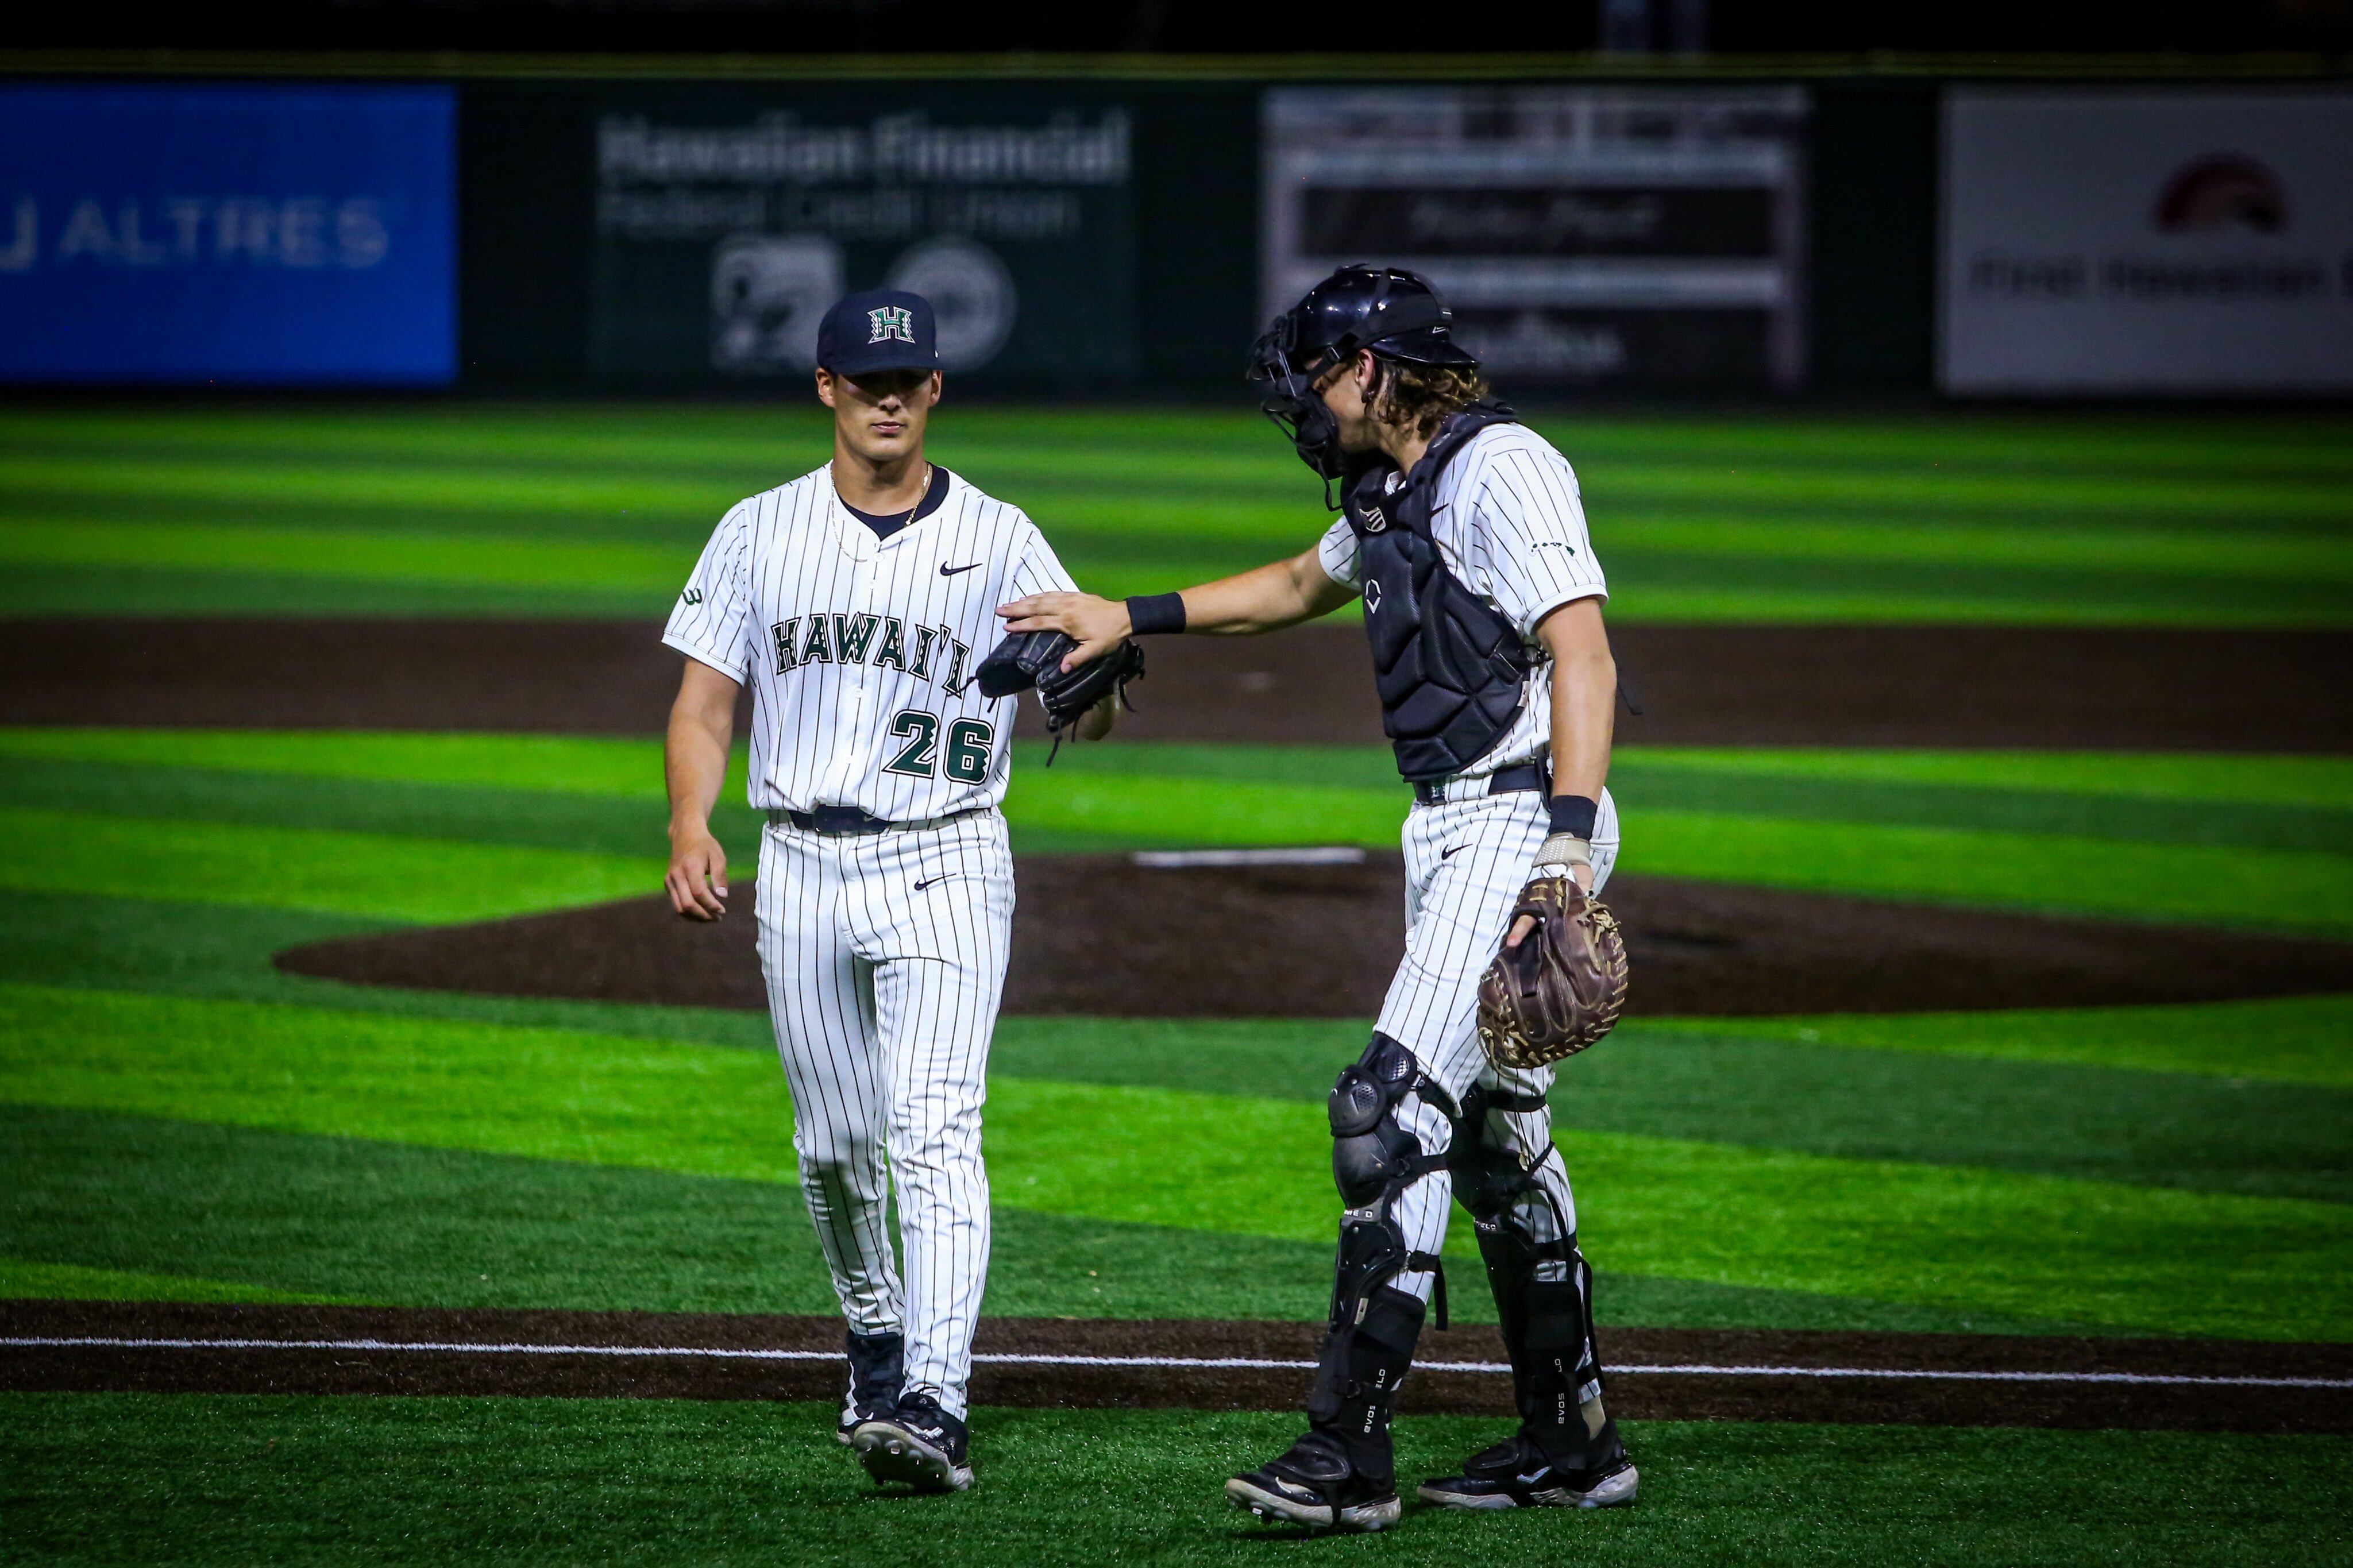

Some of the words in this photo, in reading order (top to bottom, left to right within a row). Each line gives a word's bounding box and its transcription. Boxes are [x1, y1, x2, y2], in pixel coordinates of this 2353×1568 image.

[871, 111, 1131, 184] Financial
[57, 194, 389, 269] ALTRES
[882, 709, 994, 786] 26
